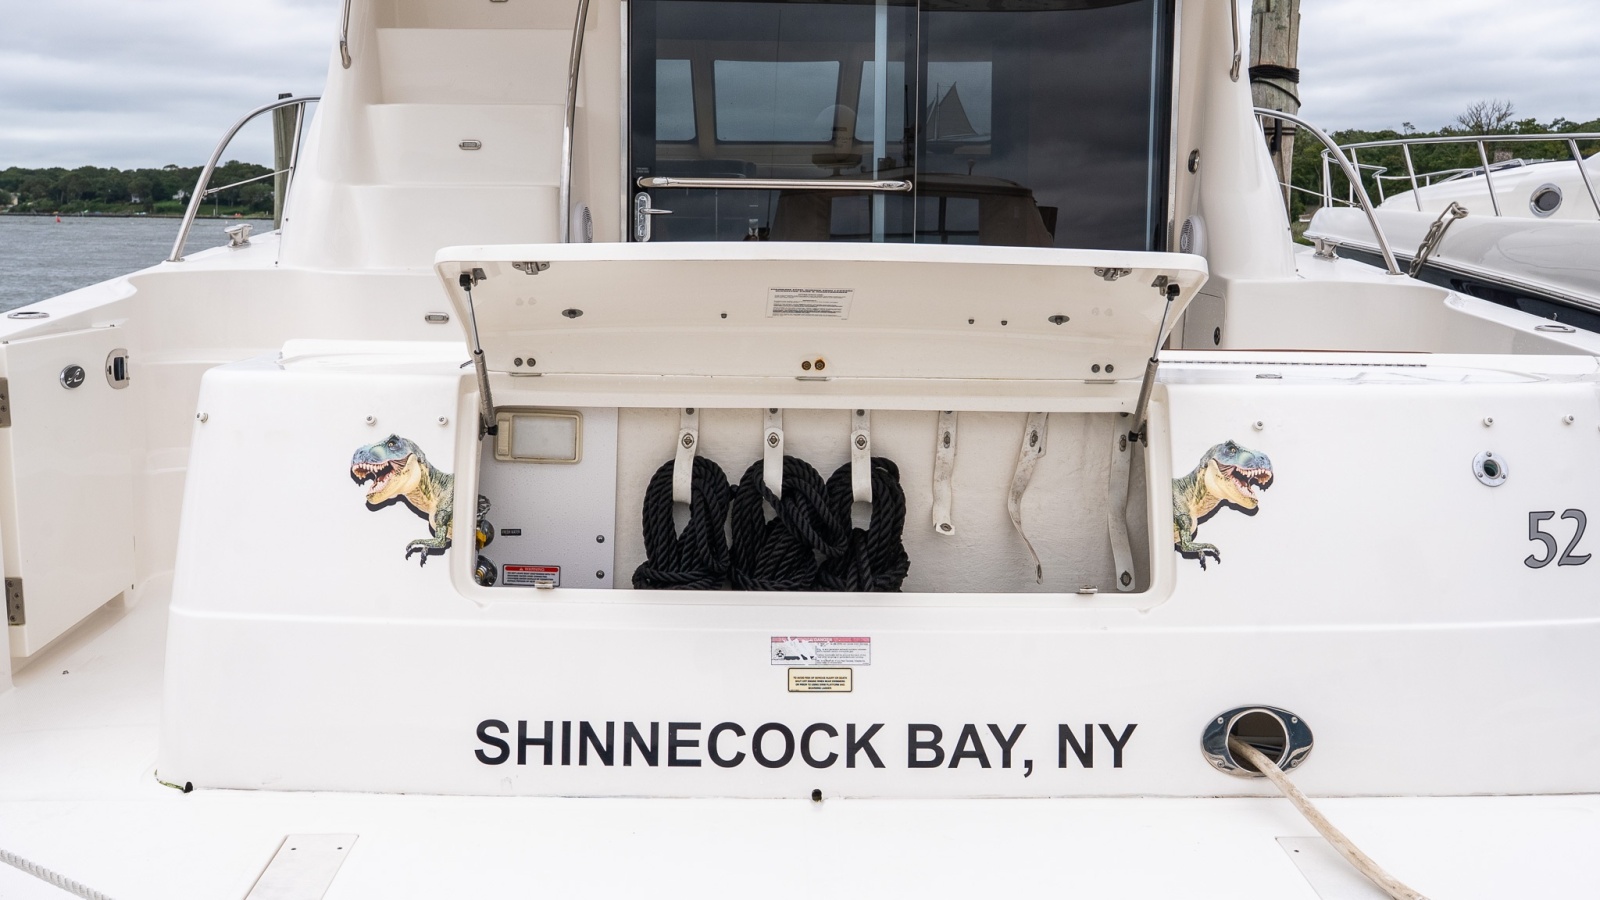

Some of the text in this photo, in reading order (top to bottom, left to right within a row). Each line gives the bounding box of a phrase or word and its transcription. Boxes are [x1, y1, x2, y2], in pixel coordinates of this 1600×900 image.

[1523, 505, 1593, 568] 52
[474, 719, 1138, 778] SHINNECOCK BAY, NY
